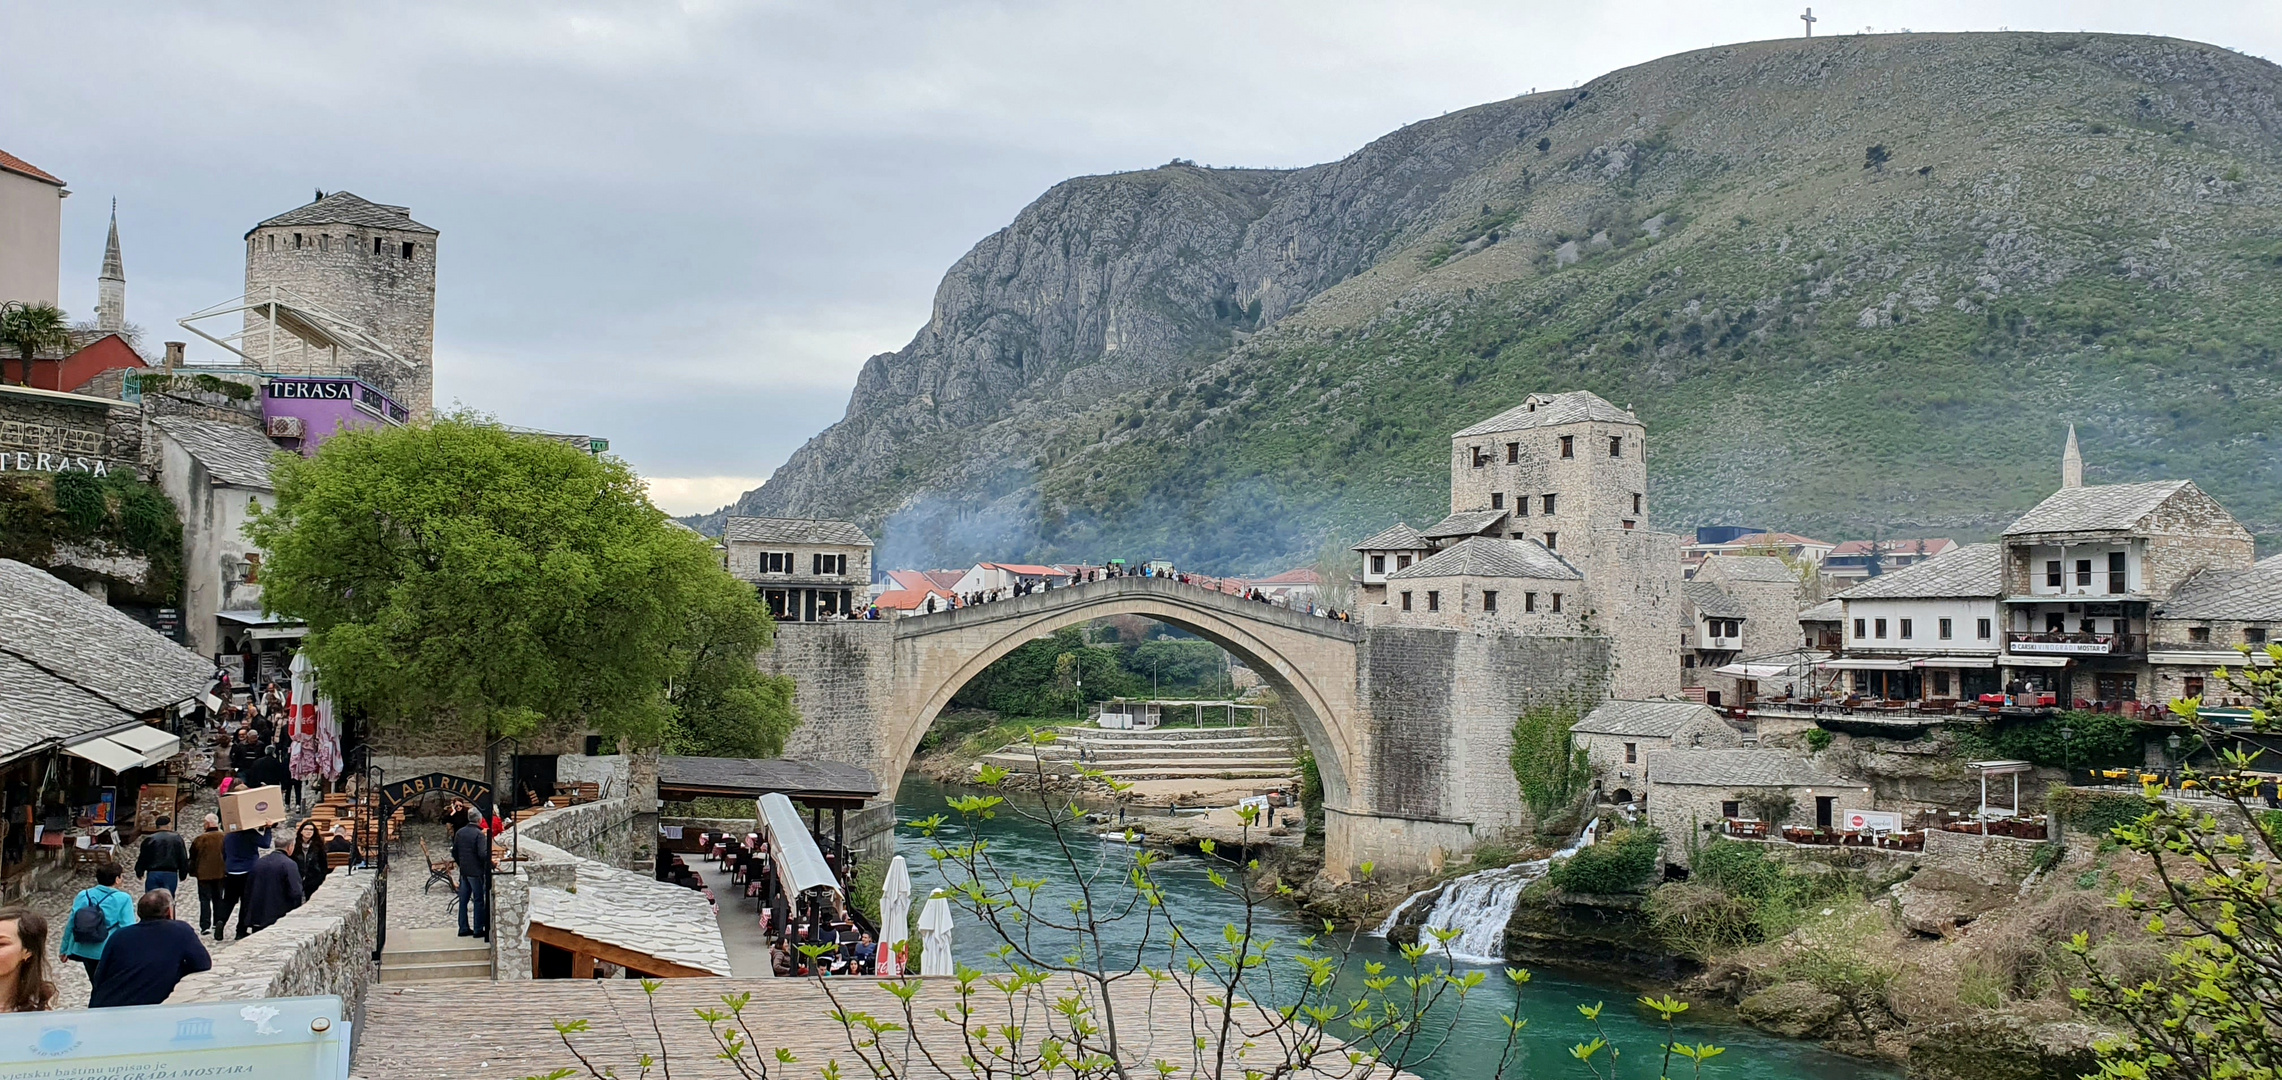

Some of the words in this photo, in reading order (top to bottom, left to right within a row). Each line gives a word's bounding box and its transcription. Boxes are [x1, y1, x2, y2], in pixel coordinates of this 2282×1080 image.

[270, 382, 351, 399] TERASA
[0, 452, 107, 478] TERASA
[384, 776, 489, 806] LABIRINT
[55, 1067, 103, 1077] baštinu
[108, 1063, 151, 1074] upisao
[155, 1061, 167, 1071] je
[180, 1064, 254, 1077] MOSTARA
